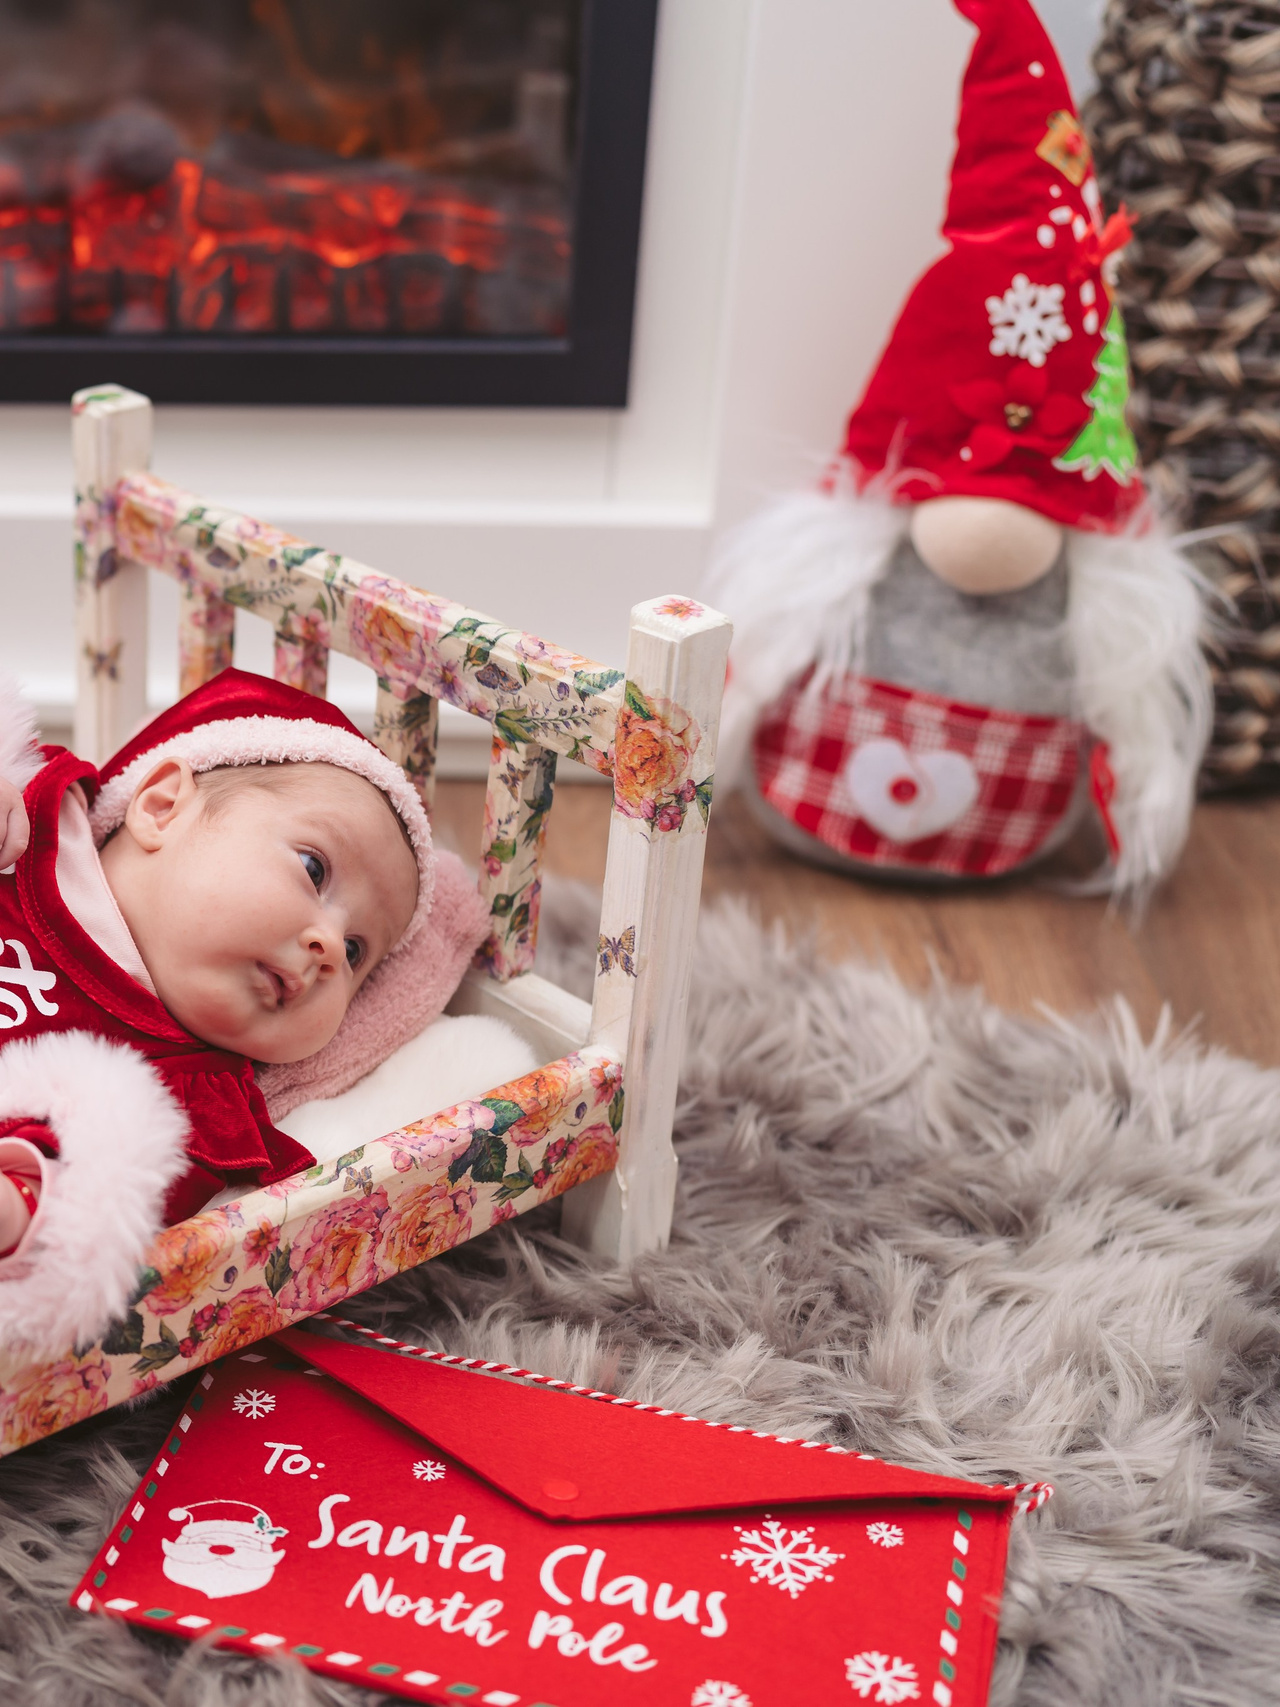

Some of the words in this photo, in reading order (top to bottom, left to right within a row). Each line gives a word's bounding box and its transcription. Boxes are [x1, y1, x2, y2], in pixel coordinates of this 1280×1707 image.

[263, 1441, 326, 1481] To:
[308, 1493, 506, 1582] Santa
[539, 1544, 728, 1638] Claus
[346, 1572, 508, 1648] North
[527, 1610, 658, 1673] Pole
